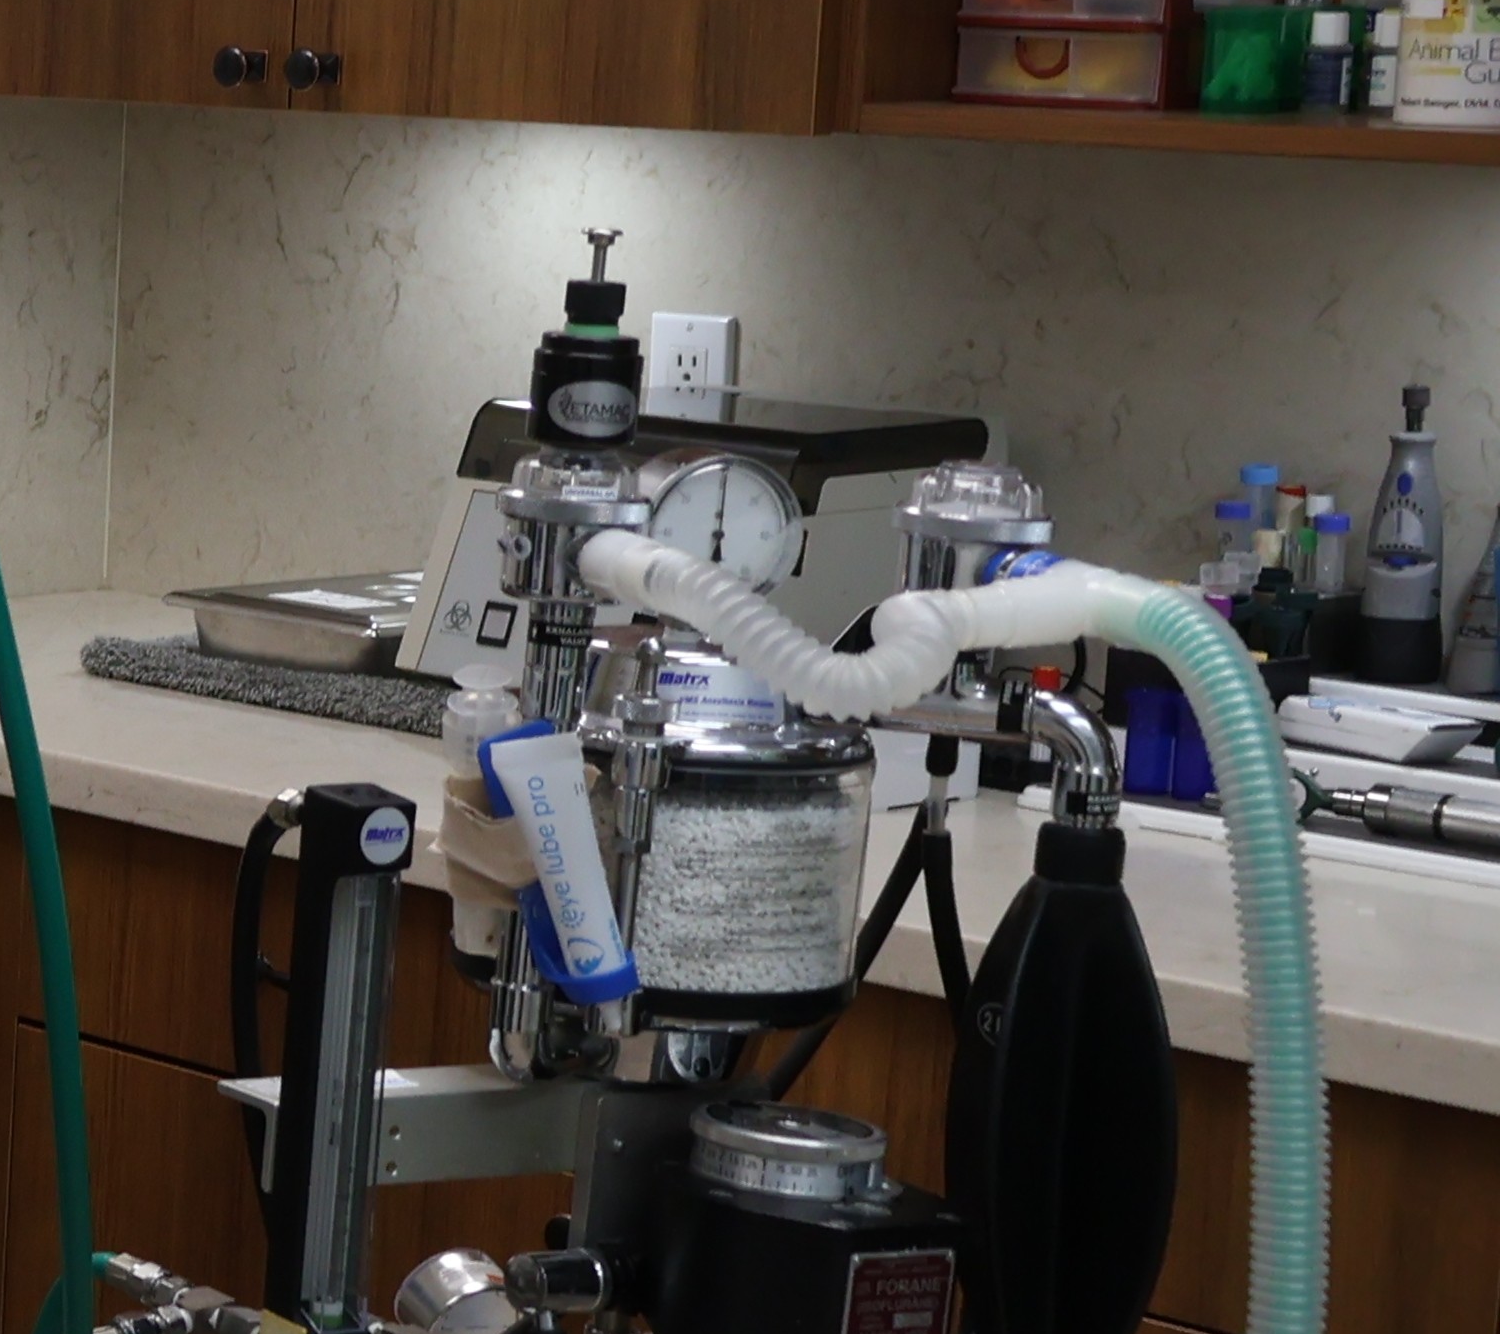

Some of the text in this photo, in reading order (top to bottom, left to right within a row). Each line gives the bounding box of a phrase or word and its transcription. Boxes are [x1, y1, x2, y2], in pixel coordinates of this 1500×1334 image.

[1409, 37, 1480, 61] Animal
[1465, 61, 1500, 84] Gu
[658, 671, 710, 687] Matrx
[365, 826, 406, 842] Matrx
[528, 775, 580, 923] eye lube pro
[876, 1276, 941, 1296] FORANE
